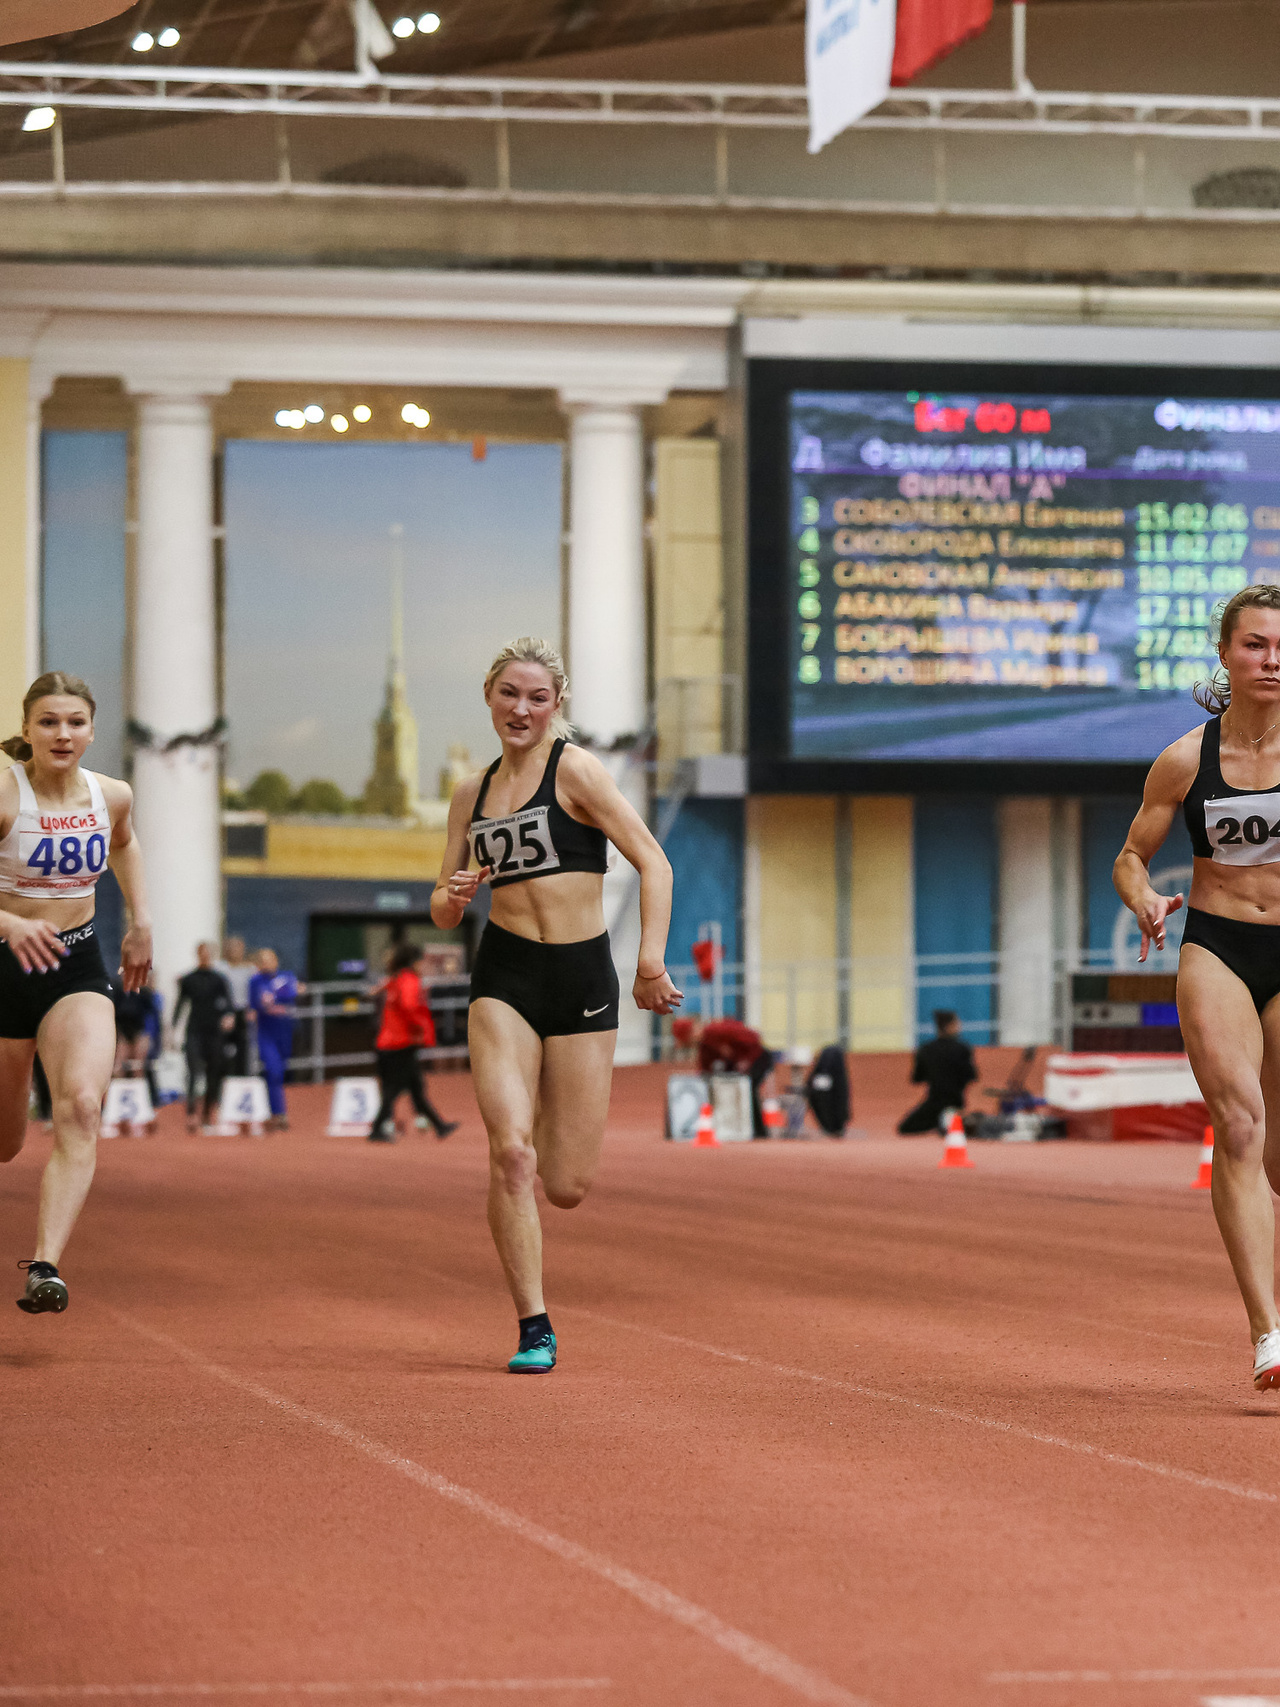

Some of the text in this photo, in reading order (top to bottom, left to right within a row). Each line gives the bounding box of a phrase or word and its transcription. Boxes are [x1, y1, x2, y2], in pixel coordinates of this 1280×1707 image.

[975, 402, 1016, 433] 60
[1021, 408, 1051, 433] м
[860, 438, 1086, 471] Фамилия Имя
[899, 472, 1011, 500] ФИНАЛ
[801, 496, 820, 524] 3
[833, 498, 1021, 526] СОБОЛЕВСКАЯ
[1136, 503, 1249, 533] 15.02.06
[799, 526, 820, 554] 4
[833, 528, 995, 557] СКОВОРОДА
[1135, 533, 1249, 563] 11.02.07
[799, 559, 820, 588] 5
[833, 561, 989, 588] САКОВСКАЯ
[798, 591, 821, 620] 6
[1135, 595, 1226, 628] 17.11.
[801, 623, 821, 652] 7
[1134, 629, 1220, 658] 27.02.
[798, 655, 821, 685] 8
[27, 834, 106, 876] 480
[474, 820, 548, 875] 425
[62, 923, 94, 946] IKE
[237, 1090, 254, 1115] 4
